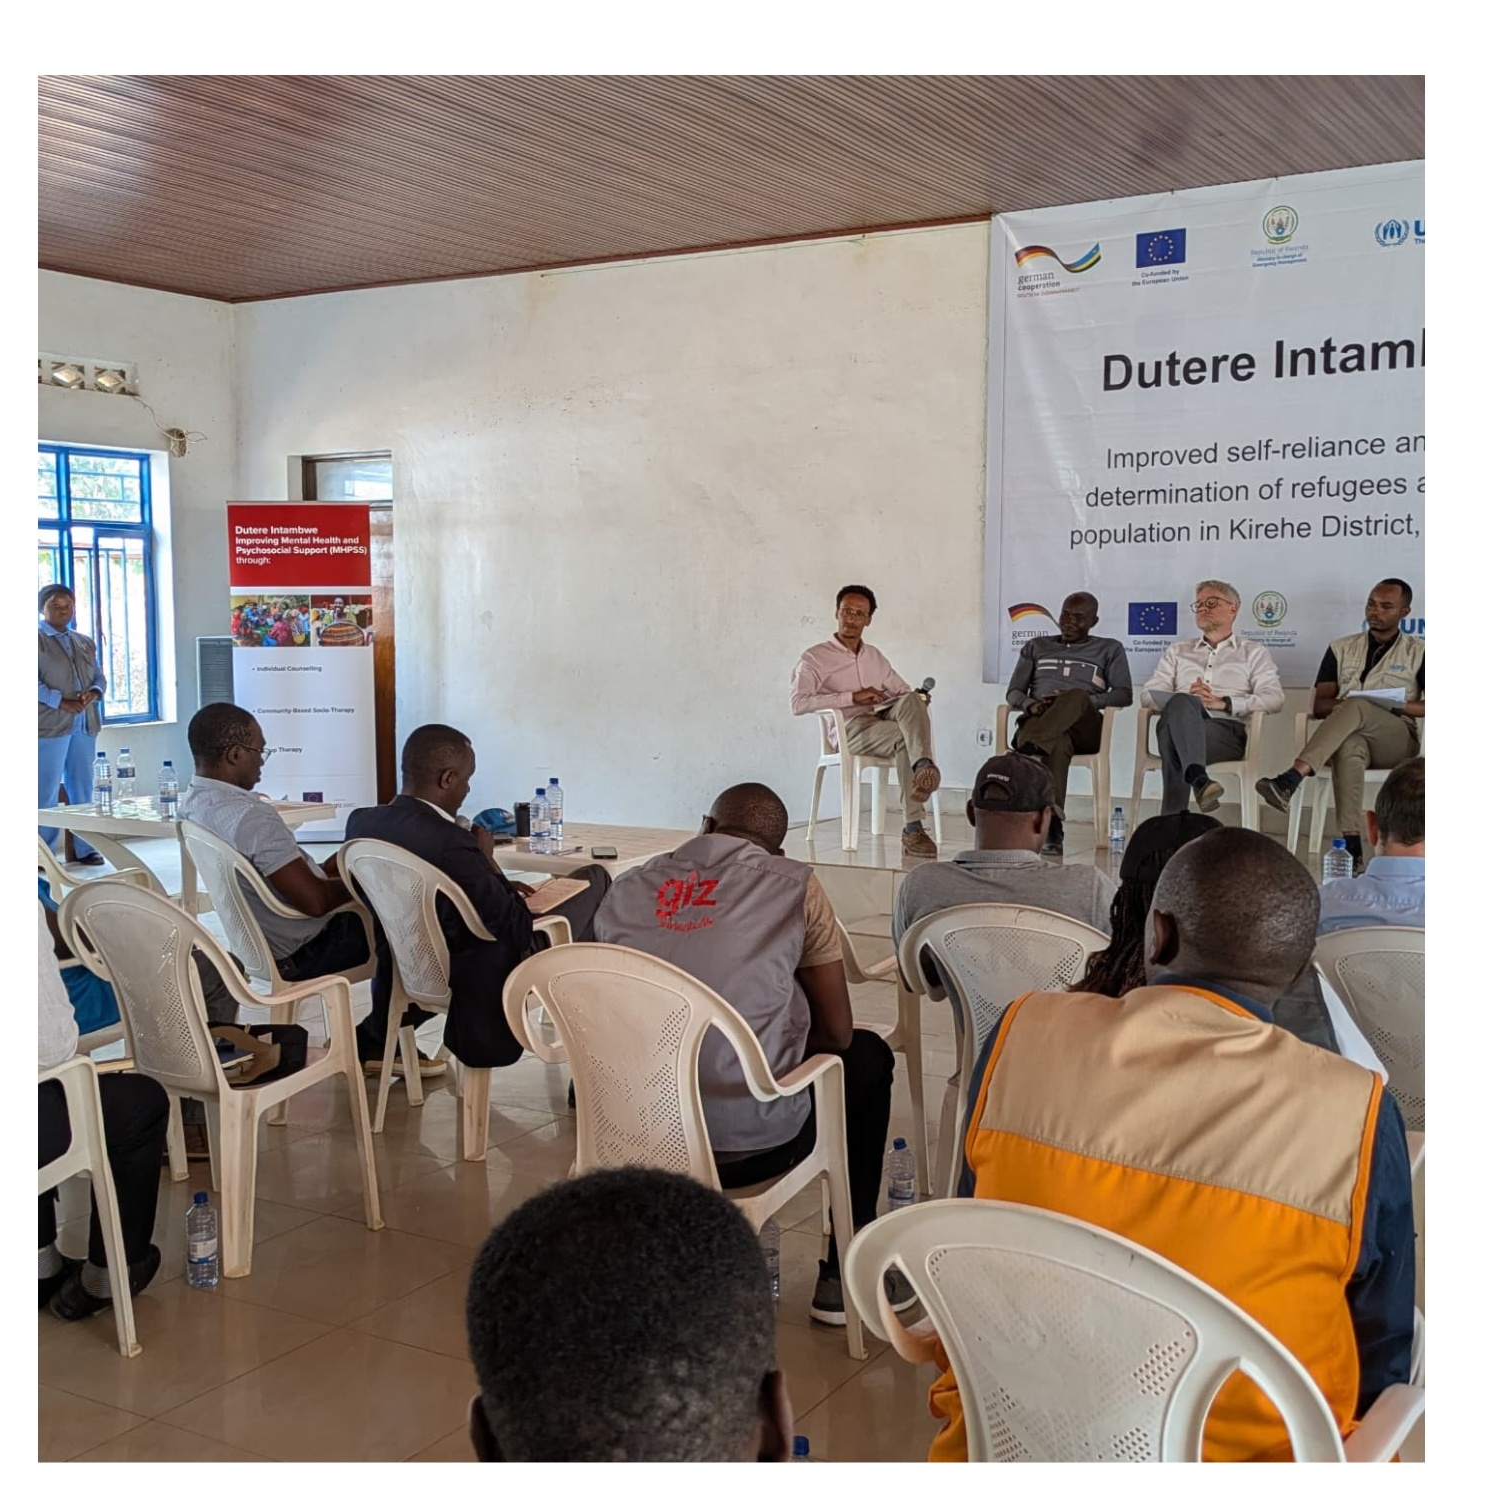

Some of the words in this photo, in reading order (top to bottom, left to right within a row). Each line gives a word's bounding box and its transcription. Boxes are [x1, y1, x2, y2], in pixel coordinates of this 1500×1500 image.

[1018, 271, 1055, 285] german
[1141, 270, 1171, 278] Co-funded
[1172, 268, 1180, 276] by
[1018, 281, 1061, 292] cooperation
[1142, 278, 1170, 286] European
[1103, 350, 1256, 391] Dutere
[1107, 442, 1217, 472] Improved
[1227, 436, 1385, 462] self-reliance
[1395, 434, 1425, 454] an
[1086, 481, 1249, 507] determination
[1259, 477, 1284, 500] of
[1291, 475, 1407, 502] refugees
[235, 526, 268, 535] Dutere
[271, 526, 318, 535] Intambwe
[1070, 522, 1190, 550] population
[1200, 520, 1220, 541] in
[1230, 518, 1311, 540] Kirehe
[1322, 513, 1419, 538] District,
[235, 537, 279, 545] Improving
[236, 546, 292, 555] Psychosocial
[293, 547, 328, 555] Support
[330, 546, 368, 555] (MHPSS)
[236, 557, 271, 565] through:
[1012, 629, 1049, 639] german
[655, 870, 719, 918] giz
